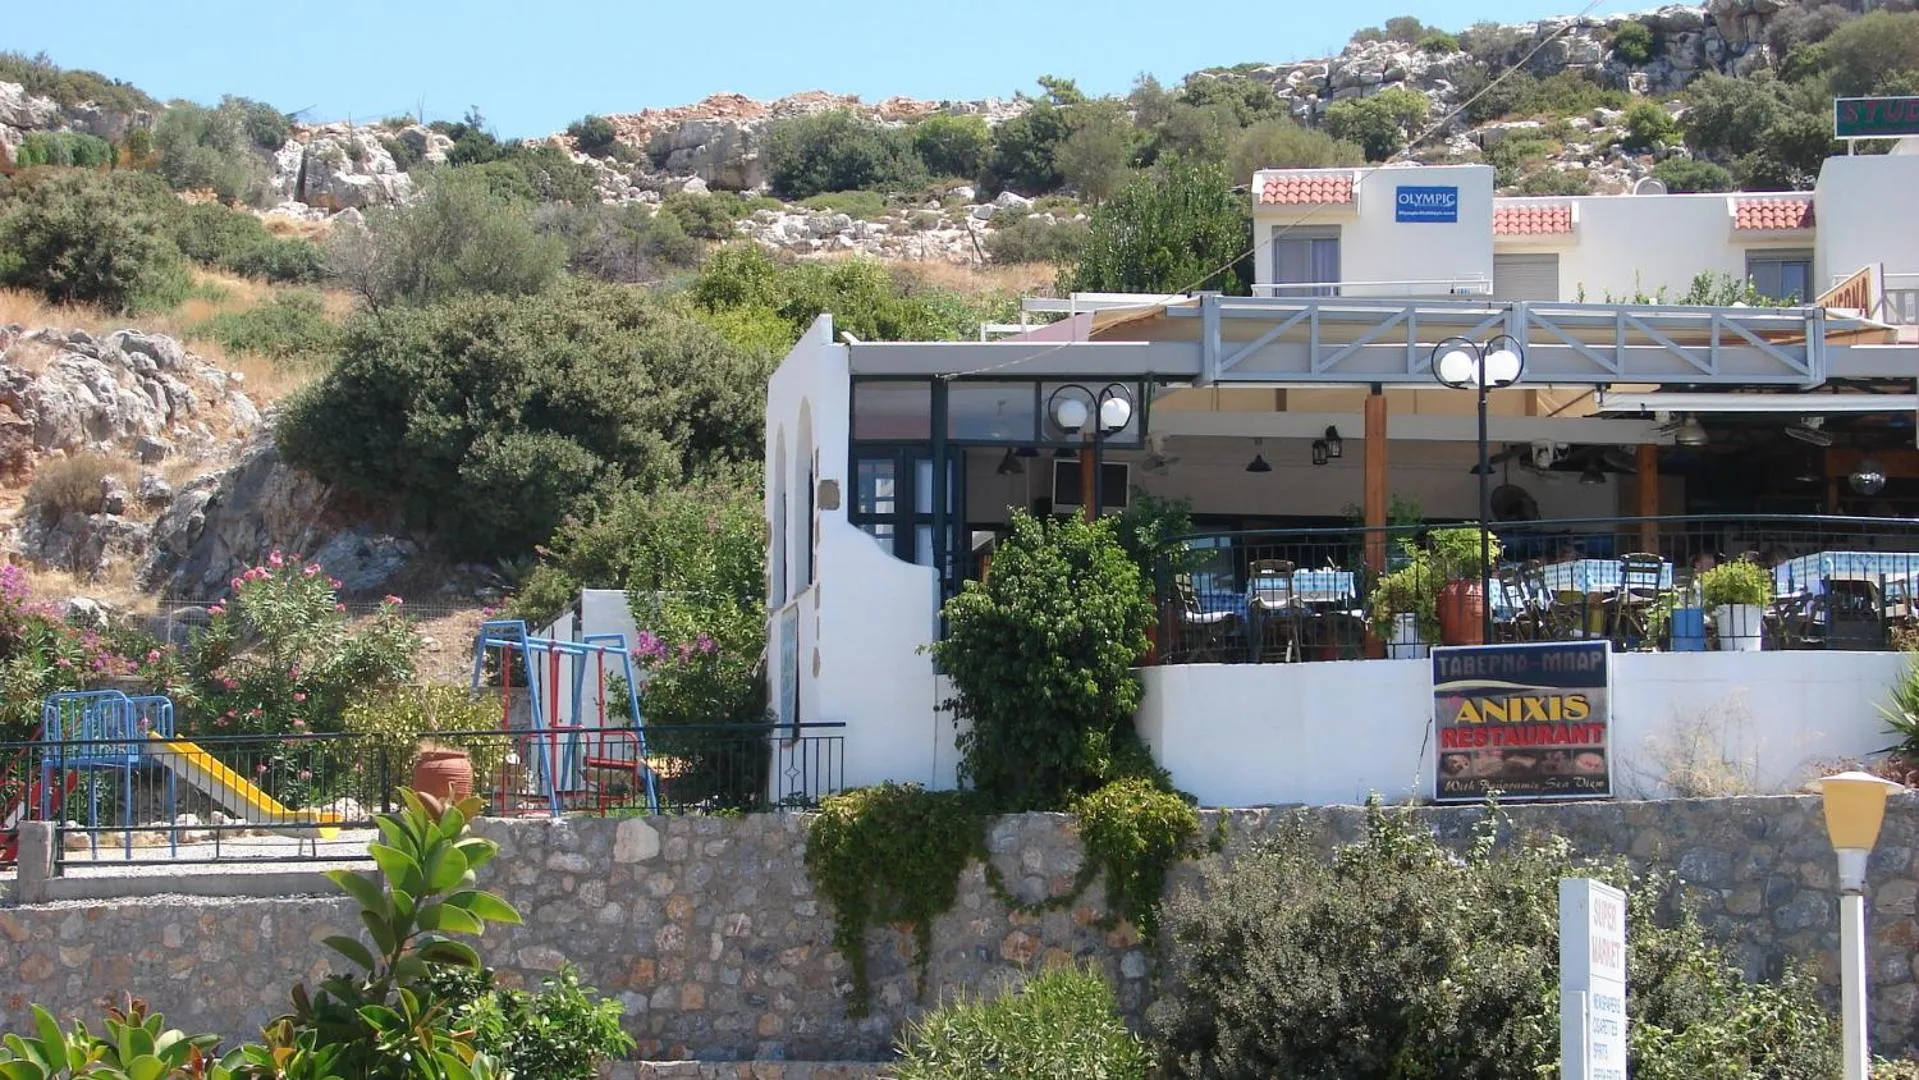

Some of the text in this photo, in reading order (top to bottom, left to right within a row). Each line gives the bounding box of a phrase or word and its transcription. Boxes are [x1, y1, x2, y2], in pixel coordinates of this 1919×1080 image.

[1398, 193, 1456, 206] OLYMPIC
[1454, 694, 1592, 724] ANIXIS
[1440, 723, 1606, 748] RESTAURANT
[1593, 897, 1617, 933] SUPER
[1591, 934, 1621, 970] MARKET
